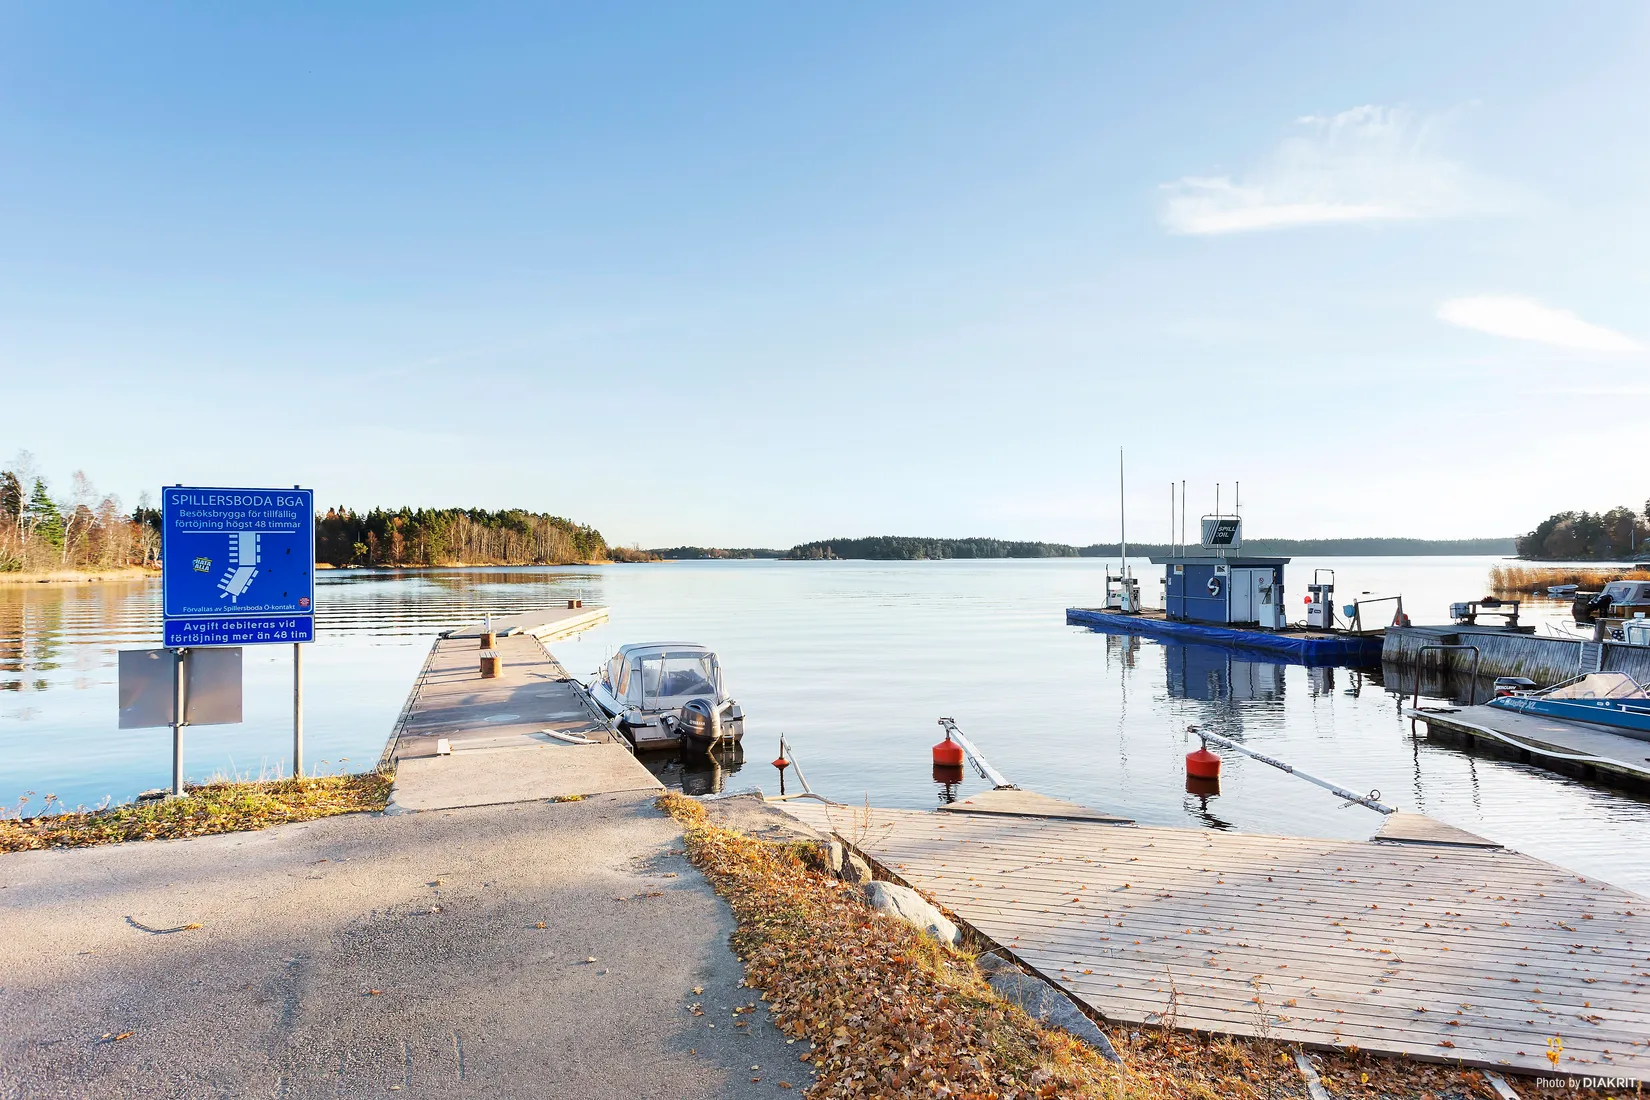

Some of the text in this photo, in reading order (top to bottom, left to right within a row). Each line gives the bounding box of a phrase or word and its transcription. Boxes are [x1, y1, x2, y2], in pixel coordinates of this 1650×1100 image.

[172, 494, 304, 507] SPILLERSBODA BGA
[180, 510, 296, 519] Besöksbrygga för tillfällig
[175, 520, 223, 529] förtöjning
[226, 520, 252, 528] högst
[269, 520, 301, 528] timmar
[184, 620, 295, 632] Avgift debiteras vid
[170, 633, 228, 642] förtöjning
[258, 631, 270, 640] än
[274, 631, 287, 639] 48
